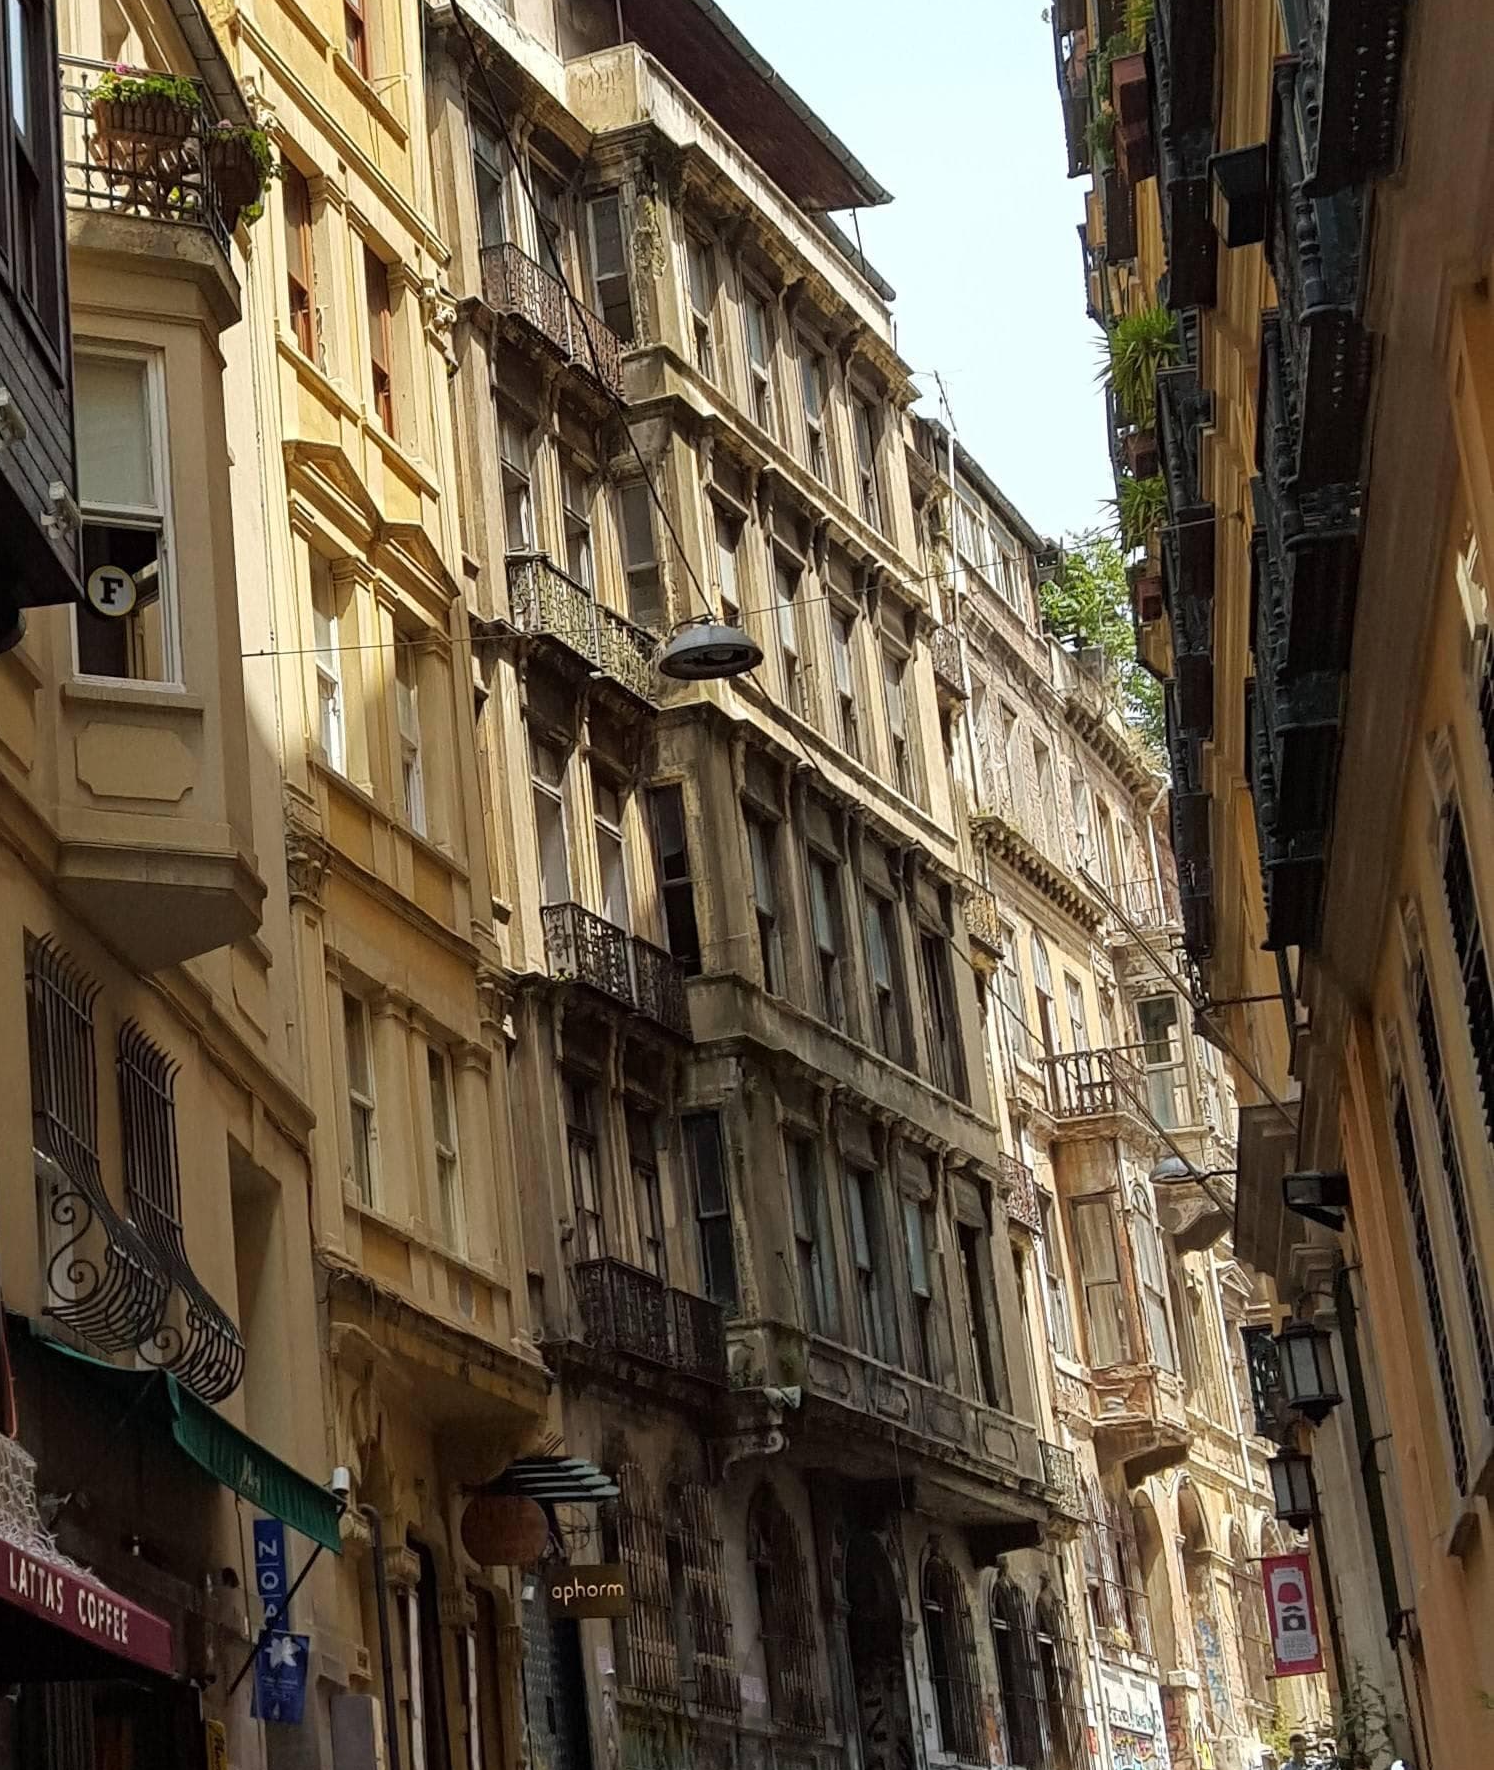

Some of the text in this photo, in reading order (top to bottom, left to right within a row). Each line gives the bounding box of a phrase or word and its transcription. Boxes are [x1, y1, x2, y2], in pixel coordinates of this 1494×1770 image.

[100, 575, 124, 606] F
[8, 1551, 129, 1645] LATTAS COFFEE
